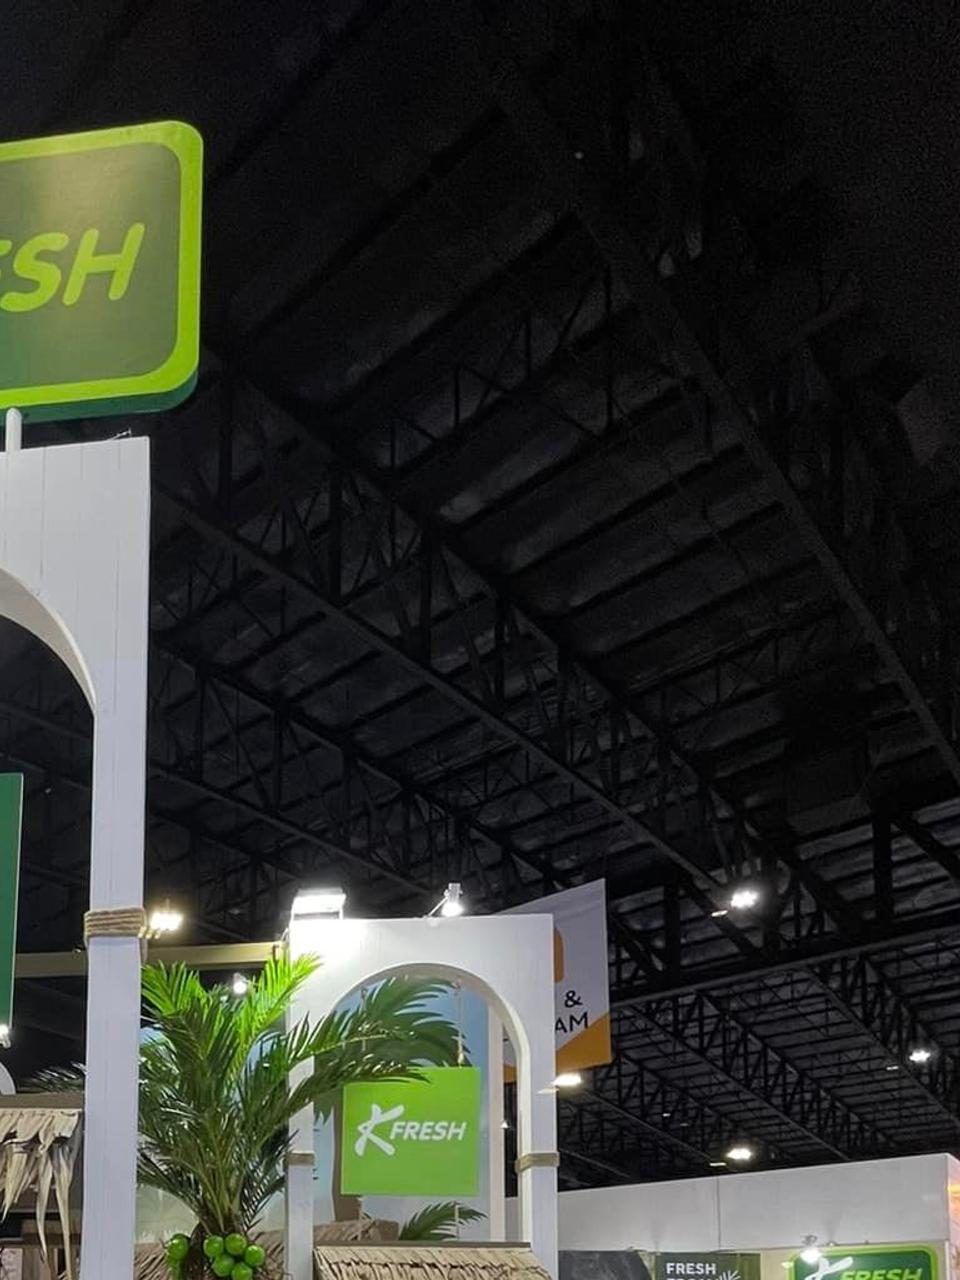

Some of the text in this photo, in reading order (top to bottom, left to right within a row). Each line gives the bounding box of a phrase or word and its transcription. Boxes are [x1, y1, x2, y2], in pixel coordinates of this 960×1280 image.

[564, 990, 583, 1008] &
[355, 1104, 467, 1156] K FRESH
[666, 1263, 716, 1275] FRESH
